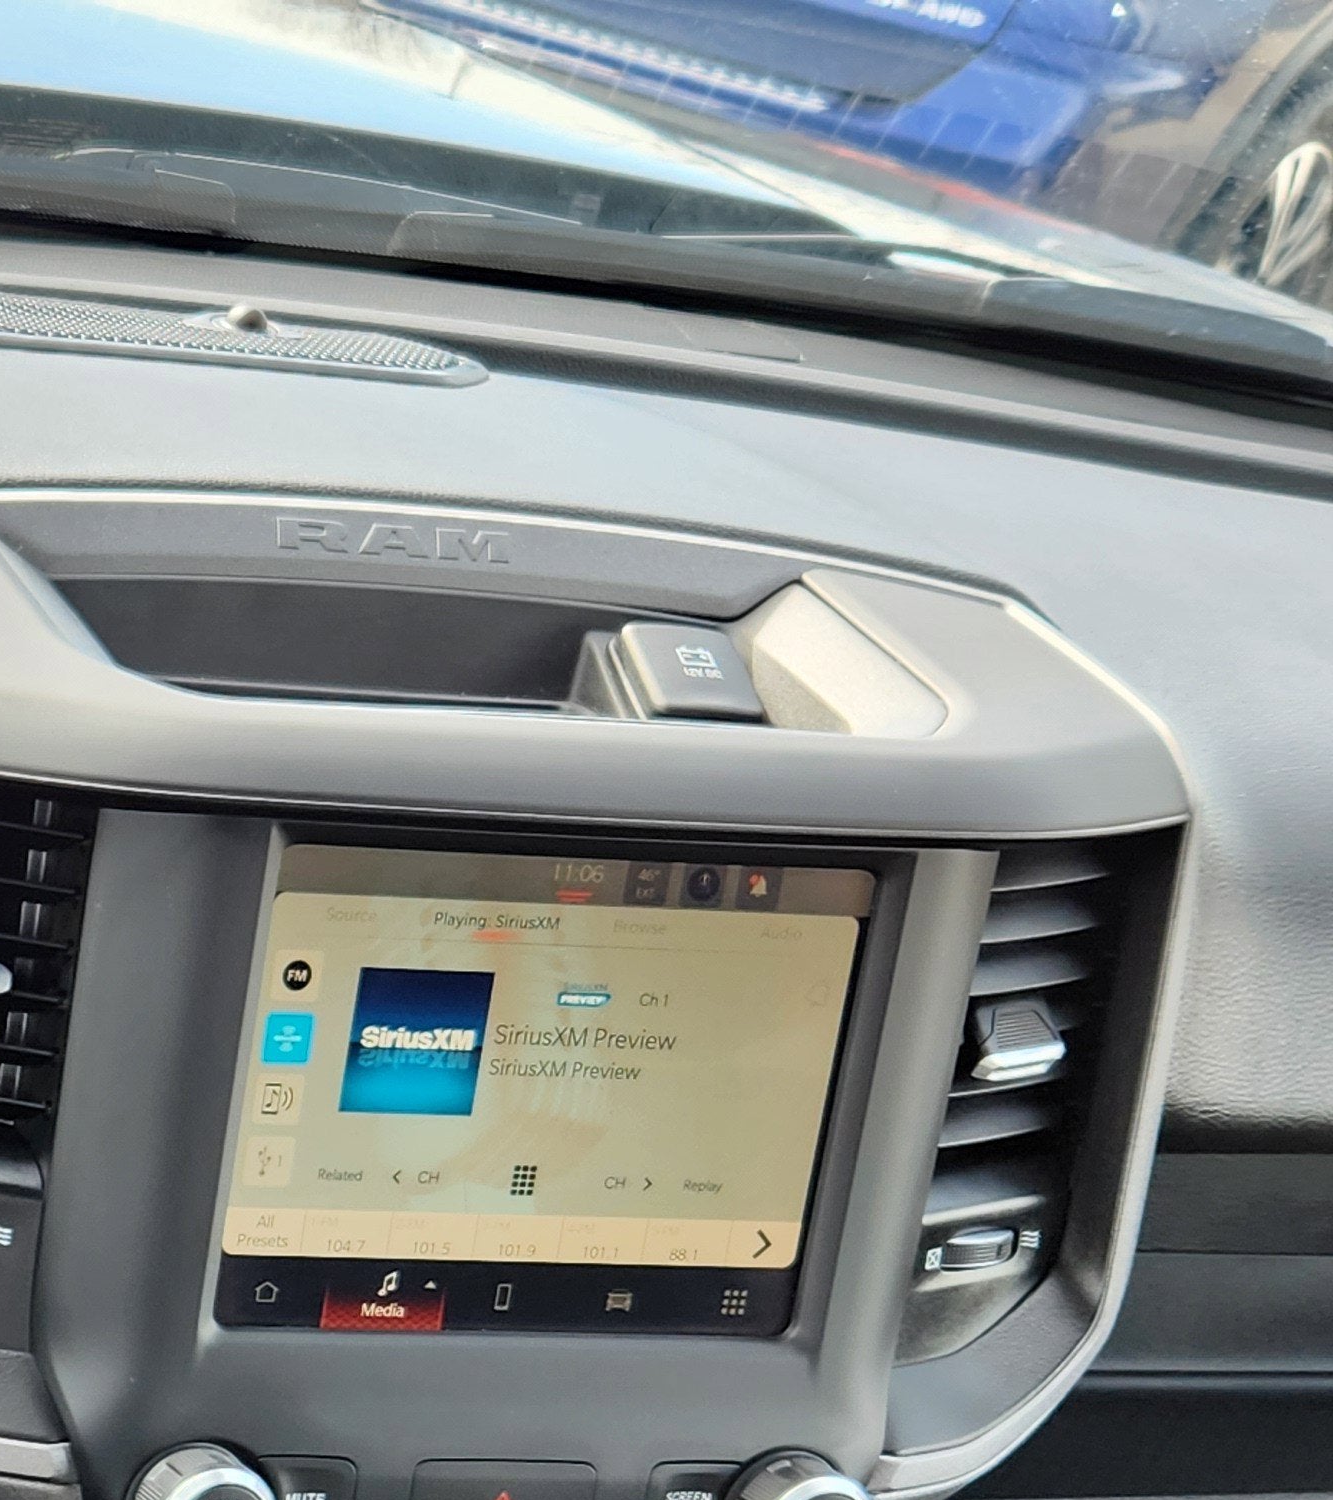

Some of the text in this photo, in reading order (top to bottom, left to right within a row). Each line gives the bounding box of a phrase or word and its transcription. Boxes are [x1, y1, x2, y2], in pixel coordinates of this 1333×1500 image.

[275, 516, 510, 564] RAM
[553, 863, 605, 884] 11:06
[325, 907, 378, 923] Source
[496, 914, 562, 930] SiriusXM
[613, 919, 666, 935] Browse
[286, 968, 309, 983] FM
[639, 992, 670, 1008] Ch 1
[360, 1026, 476, 1051] SiriusXM
[493, 1023, 677, 1050] SiriusXM Preview
[488, 1058, 641, 1081] SiriusXM Preview
[317, 1167, 363, 1183] Related
[417, 1171, 440, 1184] CH
[603, 1176, 626, 1190] CH
[682, 1179, 723, 1195] Replay
[255, 1215, 275, 1229] All
[236, 1232, 288, 1248] Presets
[326, 1240, 366, 1253] 104.7
[413, 1241, 452, 1255] 101.5
[498, 1243, 537, 1257] 101.9
[583, 1245, 619, 1259] 101.1
[669, 1248, 698, 1261] 88.1
[360, 1302, 405, 1318] Media
